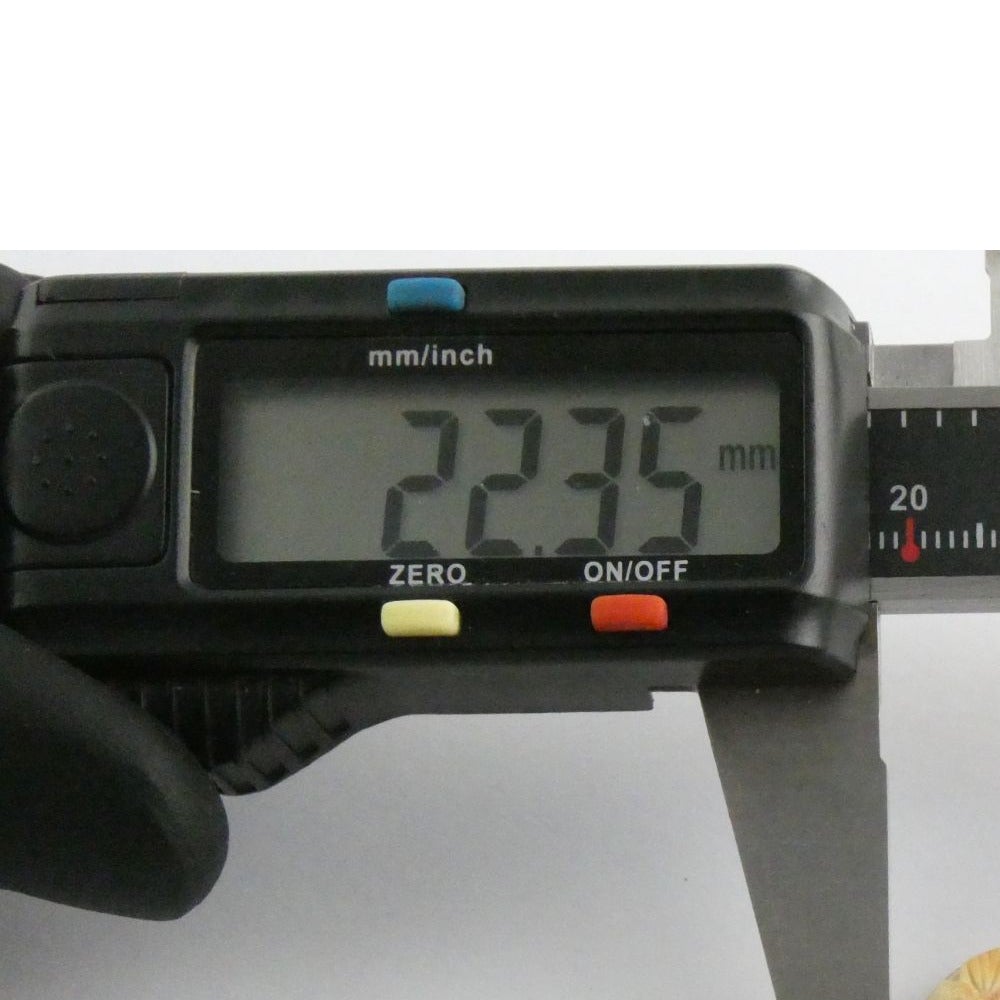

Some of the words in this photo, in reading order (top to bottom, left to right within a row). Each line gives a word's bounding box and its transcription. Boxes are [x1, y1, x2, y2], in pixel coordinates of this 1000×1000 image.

[368, 343, 493, 367] mm/inch
[382, 406, 702, 558] 22.35
[718, 444, 778, 471] mm
[889, 484, 928, 511] 20
[389, 563, 467, 586] ZERO
[583, 559, 689, 583] ON/OFF
